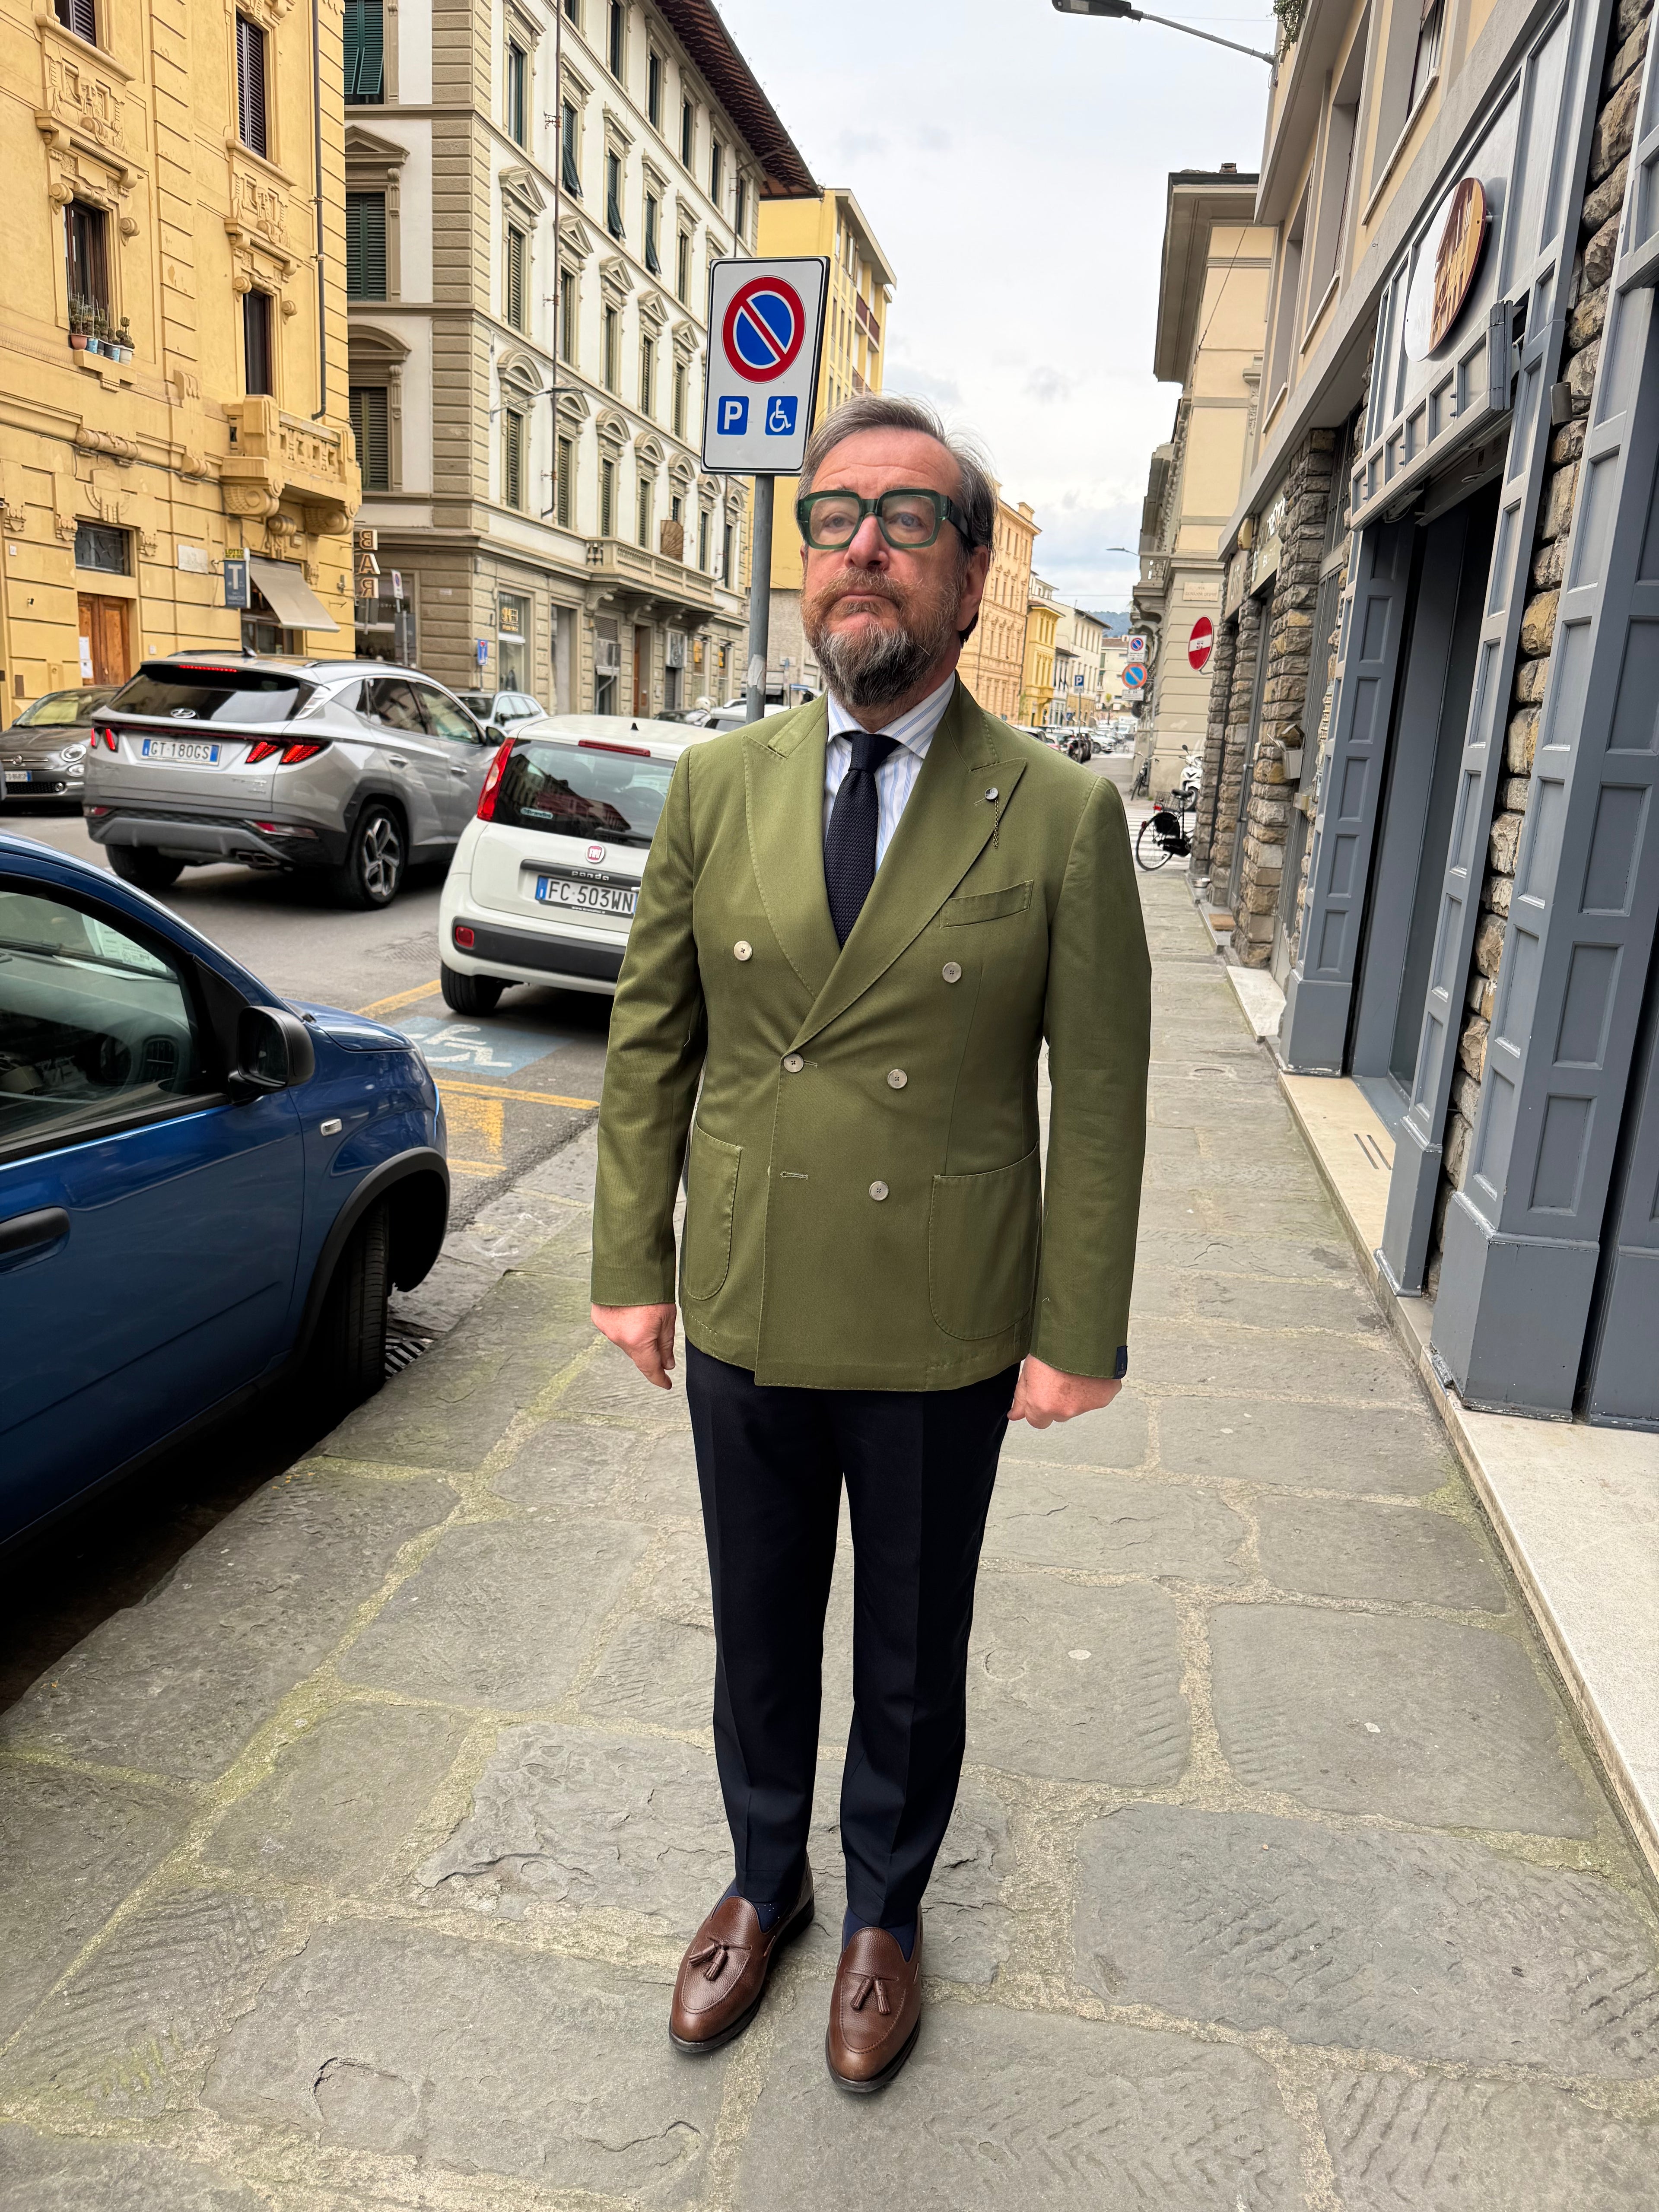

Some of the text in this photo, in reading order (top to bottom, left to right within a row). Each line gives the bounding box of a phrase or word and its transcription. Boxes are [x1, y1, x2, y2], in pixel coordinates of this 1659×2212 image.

[724, 401, 743, 430] P
[228, 564, 243, 590] T
[1076, 676, 1082, 686] P
[151, 742, 167, 755] GT
[172, 743, 210, 760] 180GS
[589, 849, 601, 858] FIAT
[548, 881, 571, 901] FC
[577, 886, 634, 912] 503WN
